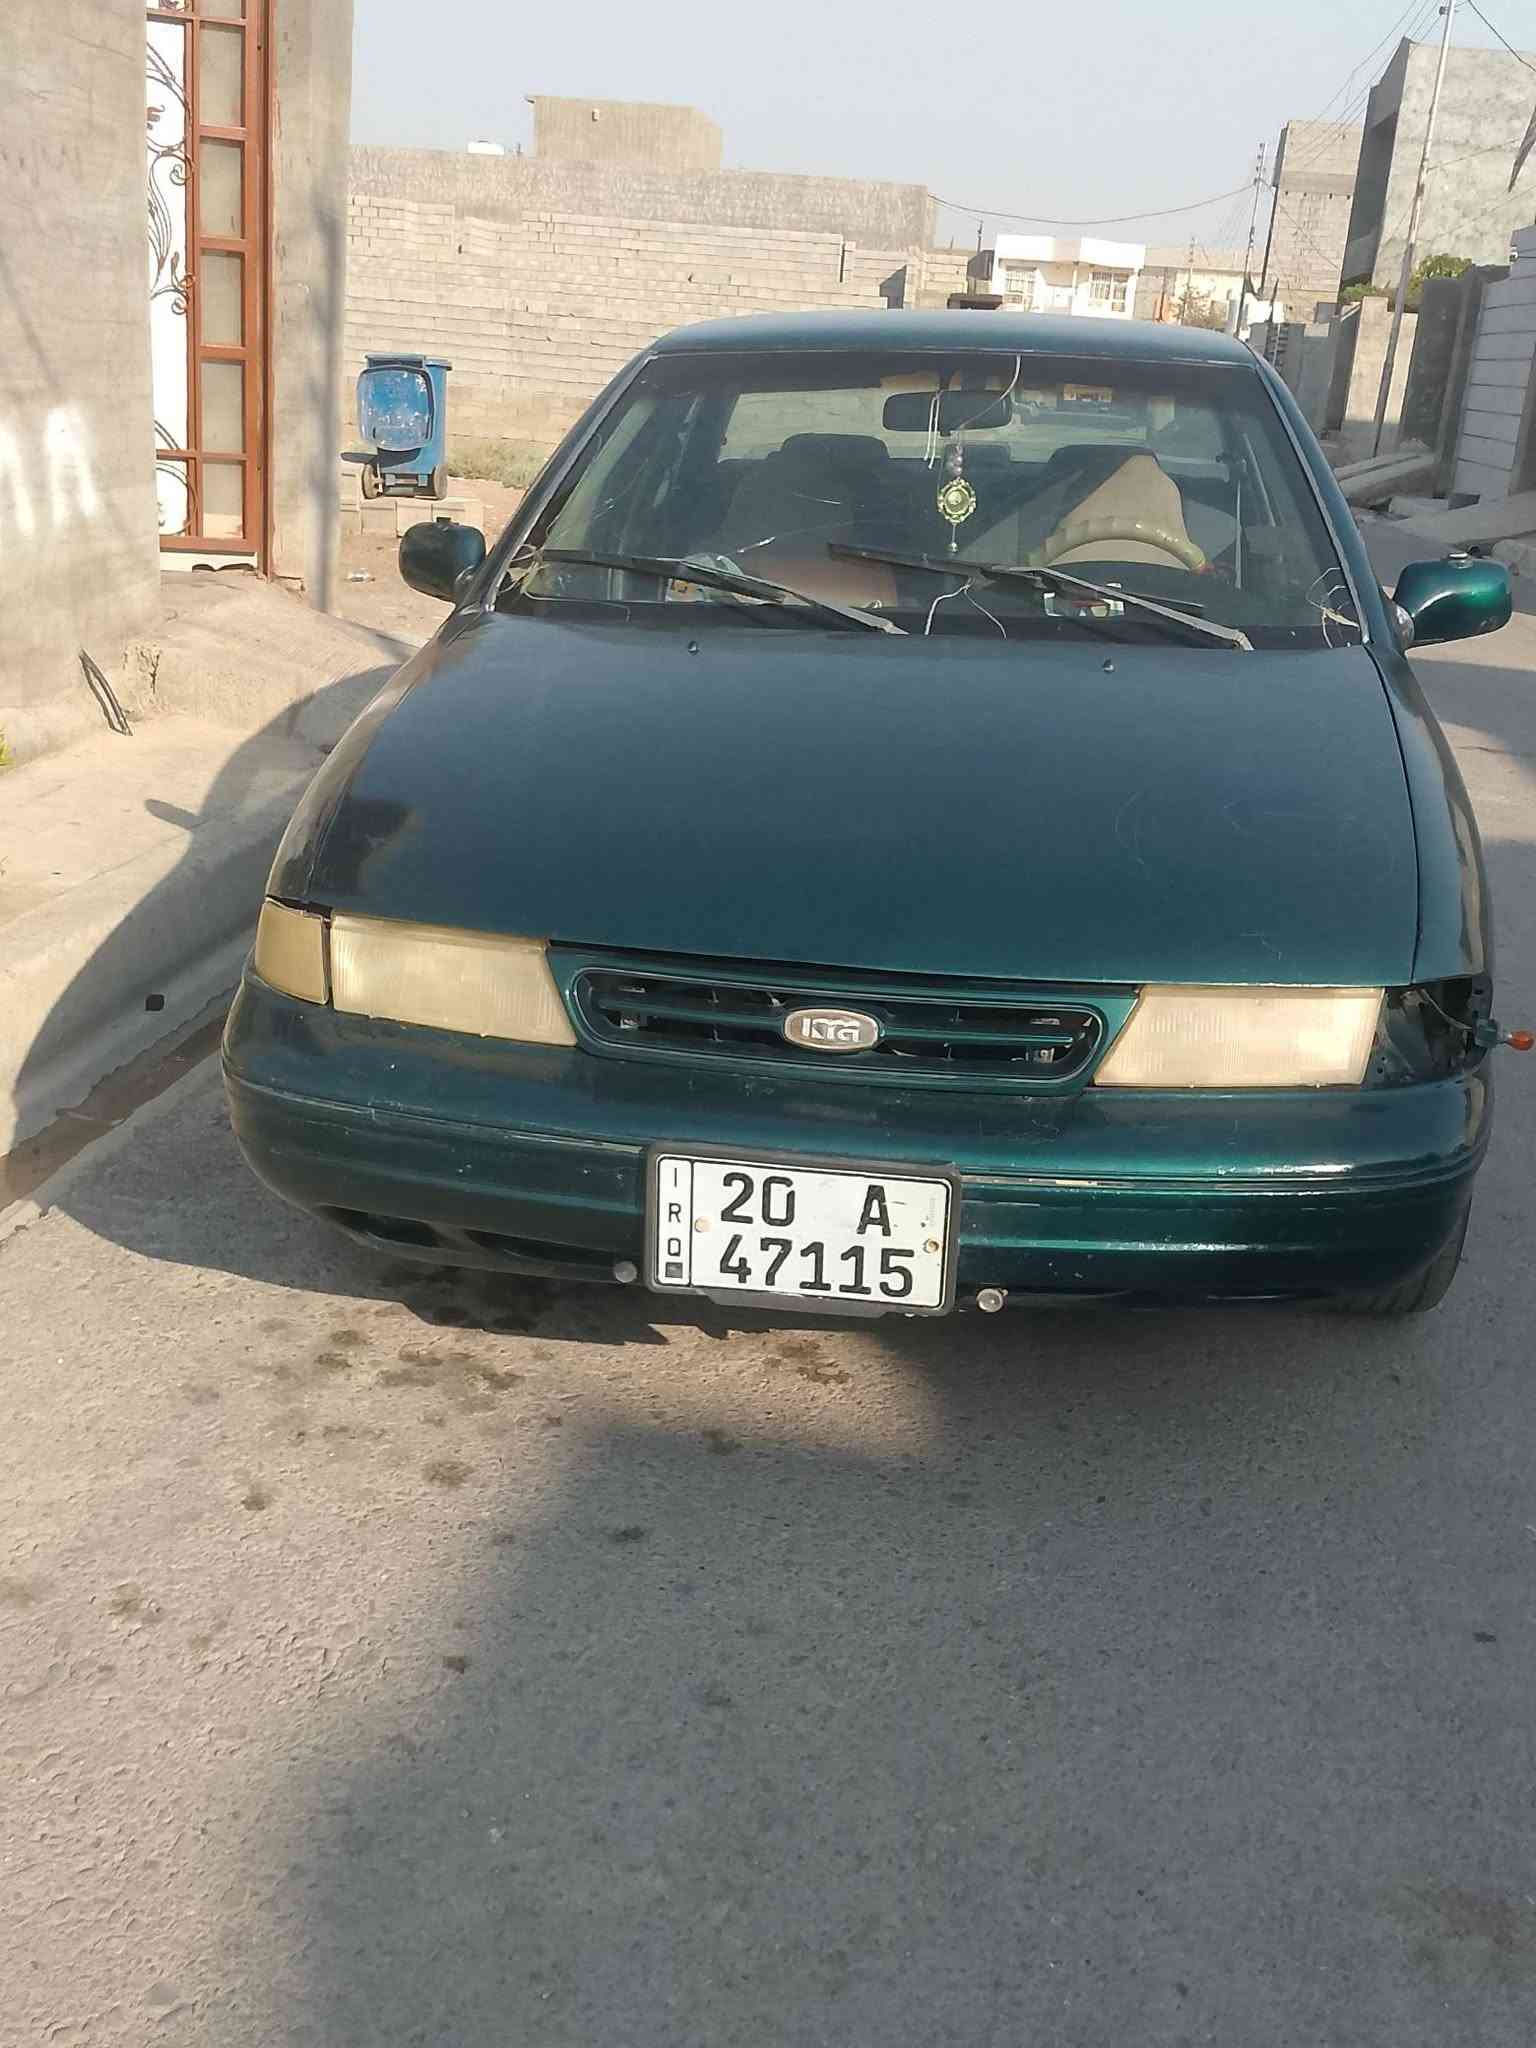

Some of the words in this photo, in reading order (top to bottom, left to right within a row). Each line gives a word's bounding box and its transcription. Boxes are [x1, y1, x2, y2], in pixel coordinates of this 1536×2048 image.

[720, 1172, 796, 1227] 20
[857, 1184, 892, 1236] A
[719, 1234, 915, 1297] 47115
